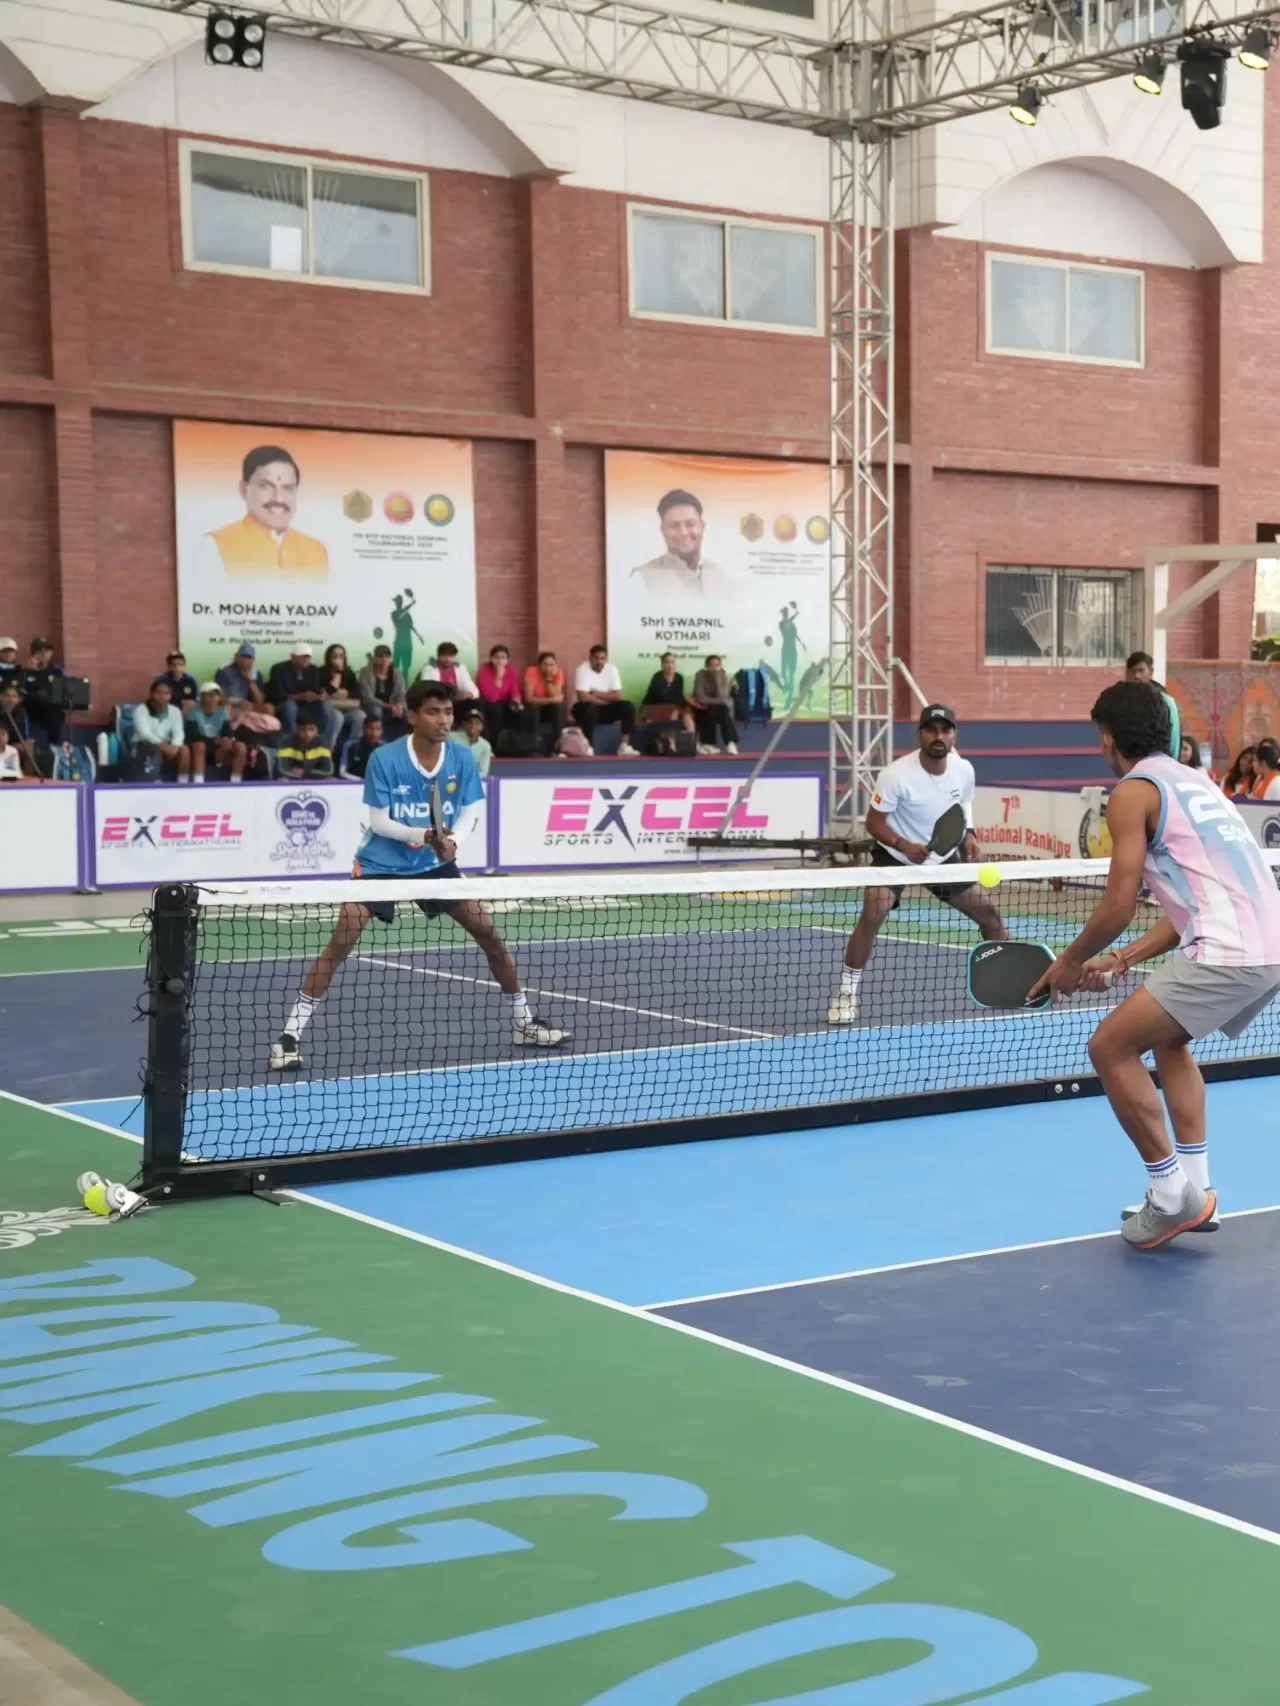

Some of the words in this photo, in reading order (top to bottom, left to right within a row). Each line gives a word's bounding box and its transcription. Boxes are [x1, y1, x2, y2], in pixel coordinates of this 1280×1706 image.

[192, 603, 214, 616] Dr.
[219, 604, 280, 616] MOHAN
[286, 605, 338, 617] YADAV
[640, 617, 664, 627] Shri
[668, 617, 724, 628] SWAPNIL
[655, 630, 710, 641] KOTHARI
[394, 800, 454, 818] INDA
[1001, 795, 1020, 823] 7th
[1175, 781, 1243, 825] 2
[546, 786, 769, 850] EXCEL
[101, 814, 243, 848] EXCEL
[544, 833, 613, 846] SPORTS
[976, 825, 1022, 844] National
[1025, 829, 1071, 859] Ranking
[980, 945, 1003, 960] JOOLA
[386, 1534, 1153, 1706] TO
